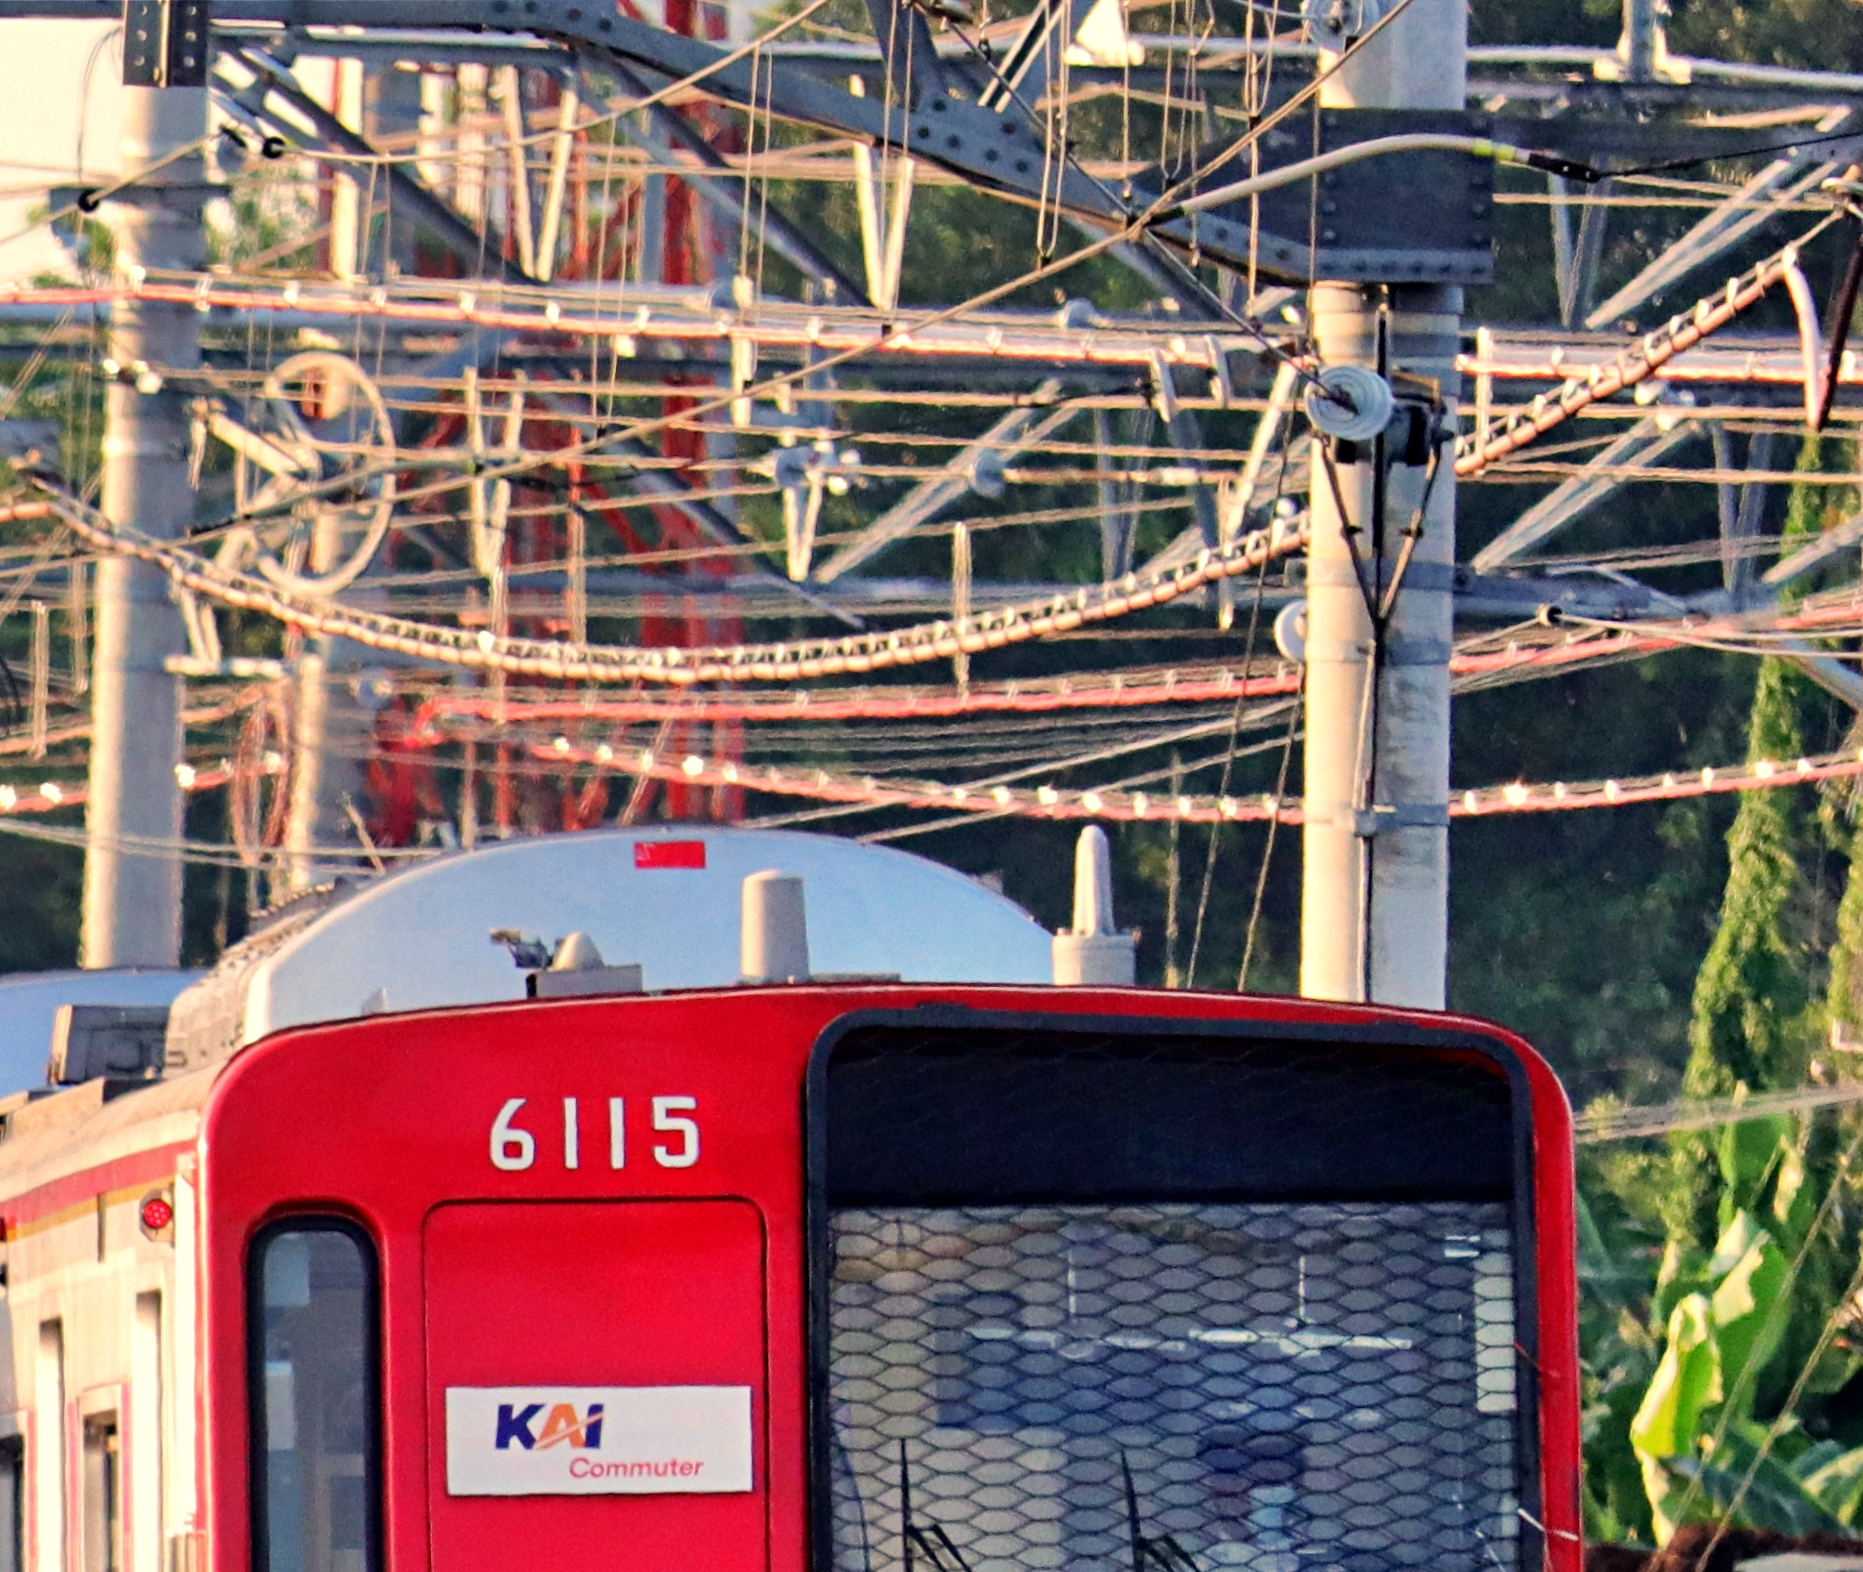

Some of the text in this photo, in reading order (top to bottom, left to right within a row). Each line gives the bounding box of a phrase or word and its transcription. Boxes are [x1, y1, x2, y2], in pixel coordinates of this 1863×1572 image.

[489, 1095, 701, 1171] 6115
[495, 1402, 605, 1451] KAI
[568, 1456, 704, 1479] Commuter
